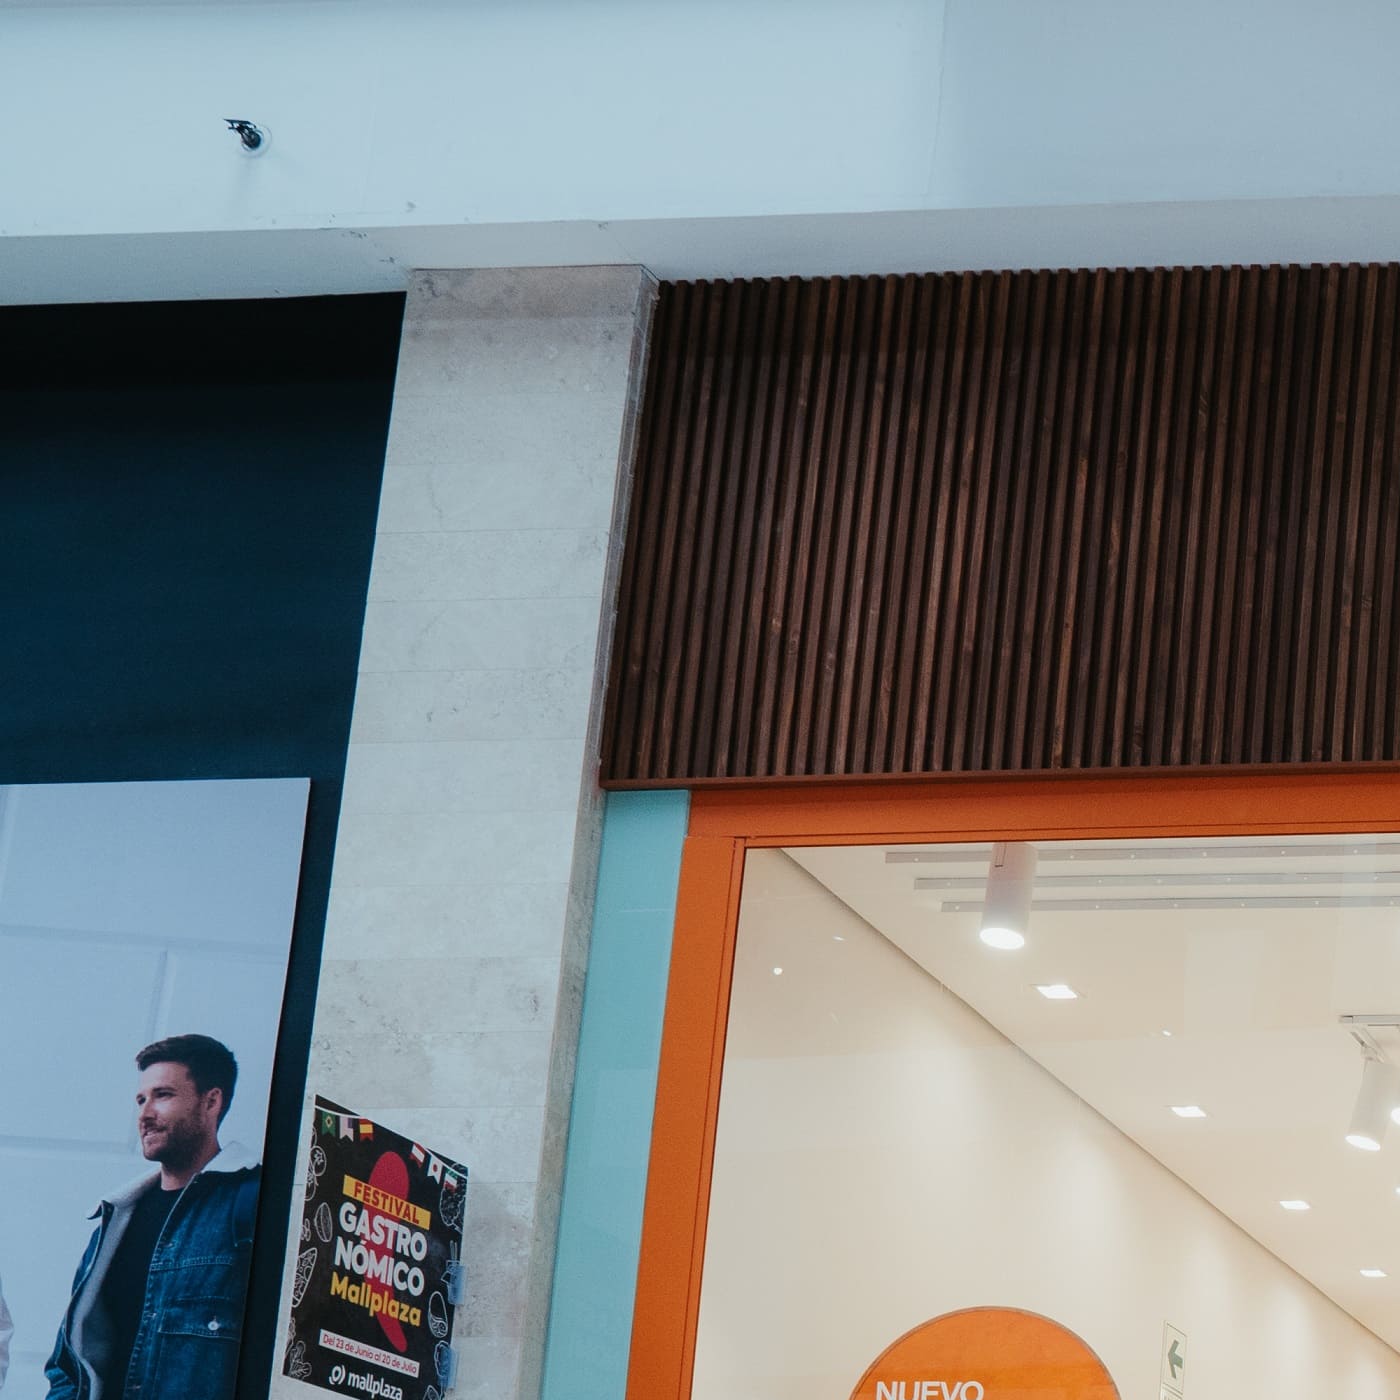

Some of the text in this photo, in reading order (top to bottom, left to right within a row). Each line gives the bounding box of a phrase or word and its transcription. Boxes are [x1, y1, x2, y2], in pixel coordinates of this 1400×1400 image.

[353, 1182, 420, 1225] FESTIVAL
[339, 1202, 428, 1262] GASTRO
[334, 1236, 425, 1297] NÓMICO
[330, 1271, 422, 1327] Mallplaza
[323, 1334, 417, 1374] Del 23 de Junio al 20 de Julio
[347, 1372, 403, 1400] mallplaza
